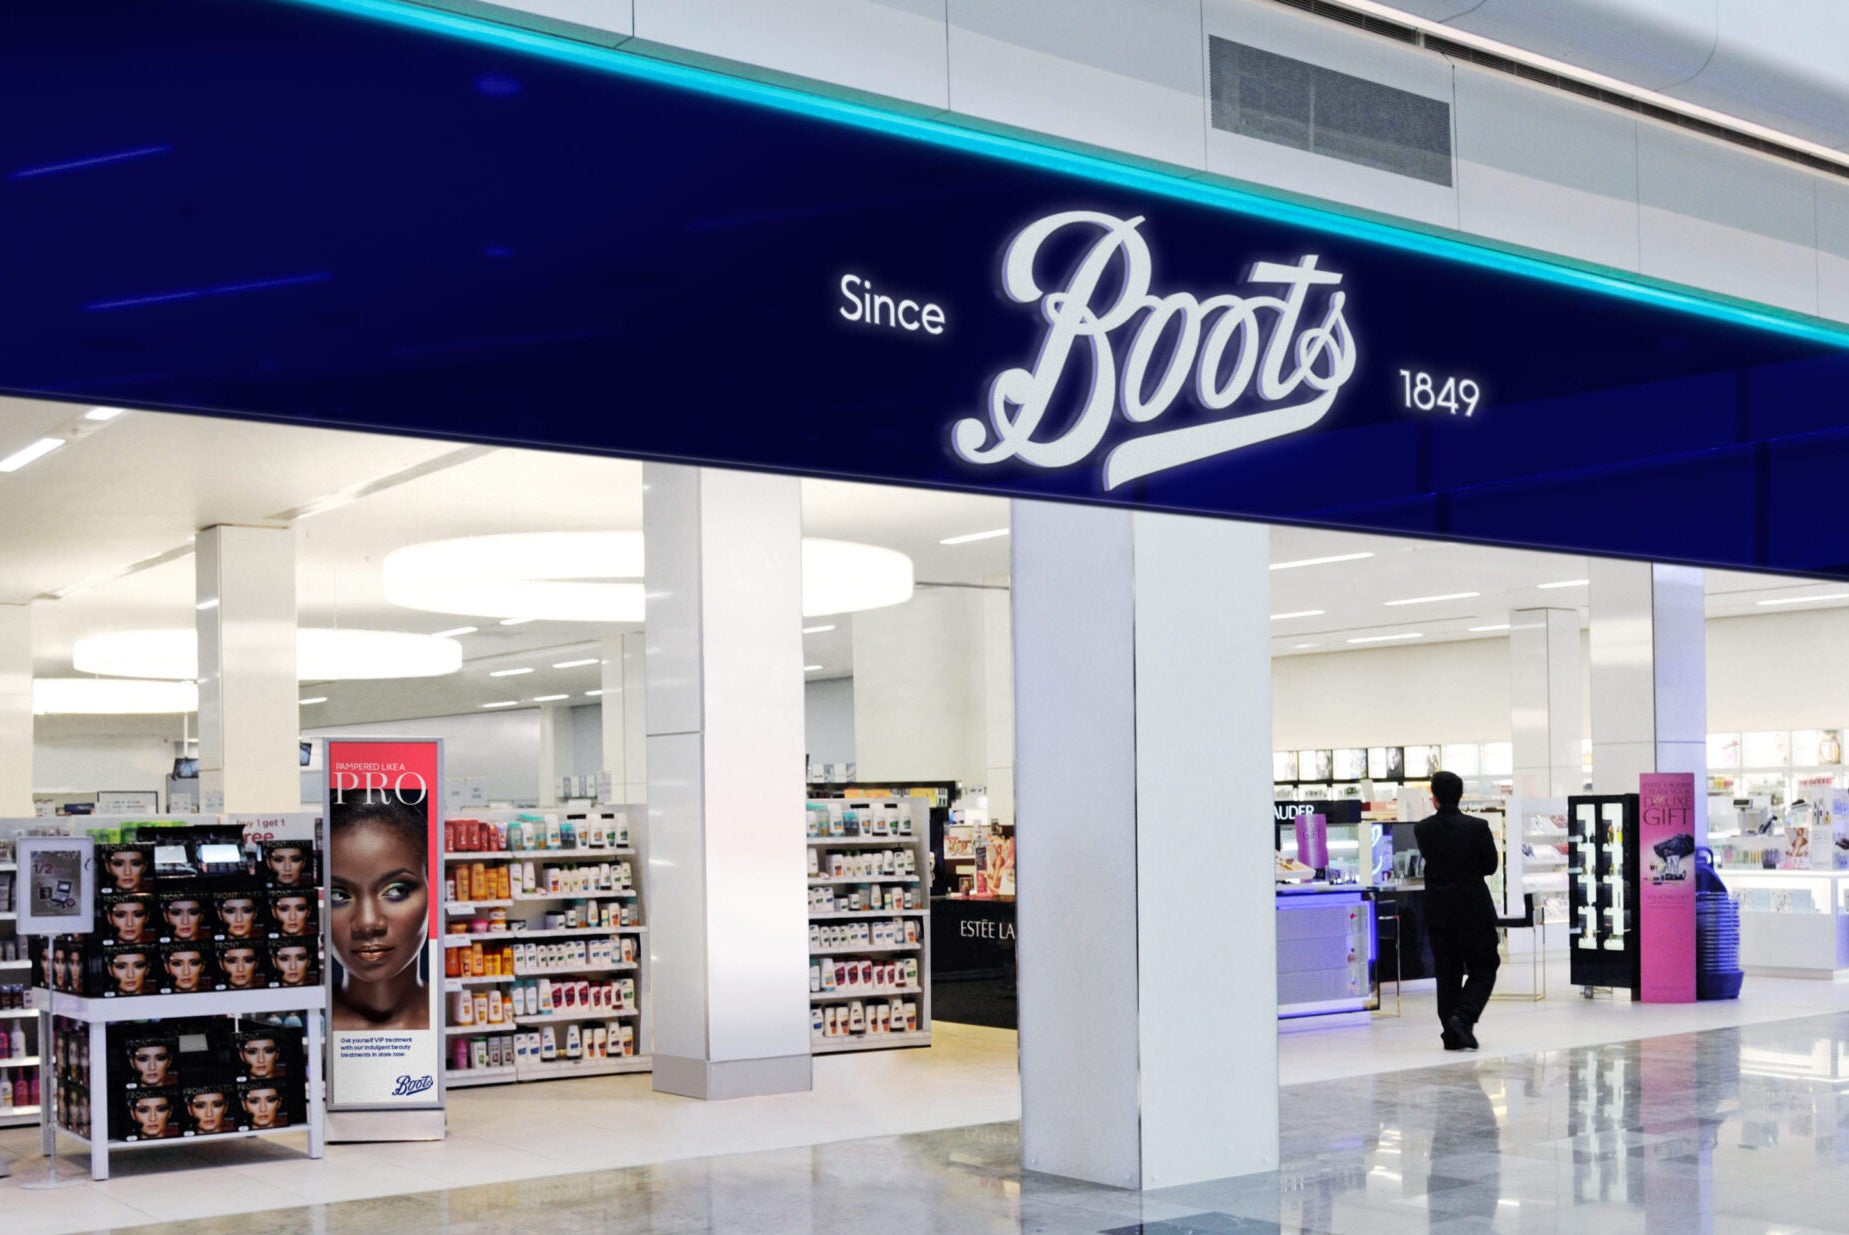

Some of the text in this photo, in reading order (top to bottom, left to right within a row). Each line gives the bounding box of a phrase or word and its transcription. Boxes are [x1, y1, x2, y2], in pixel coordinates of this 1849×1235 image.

[840, 210, 1480, 491] Since Boots 1849
[335, 762, 406, 771] PAMPERED LIKE A
[332, 771, 427, 806] PRO
[262, 818, 278, 829] get
[1643, 807, 1691, 826] GIFT
[391, 1074, 434, 1097] Boots
